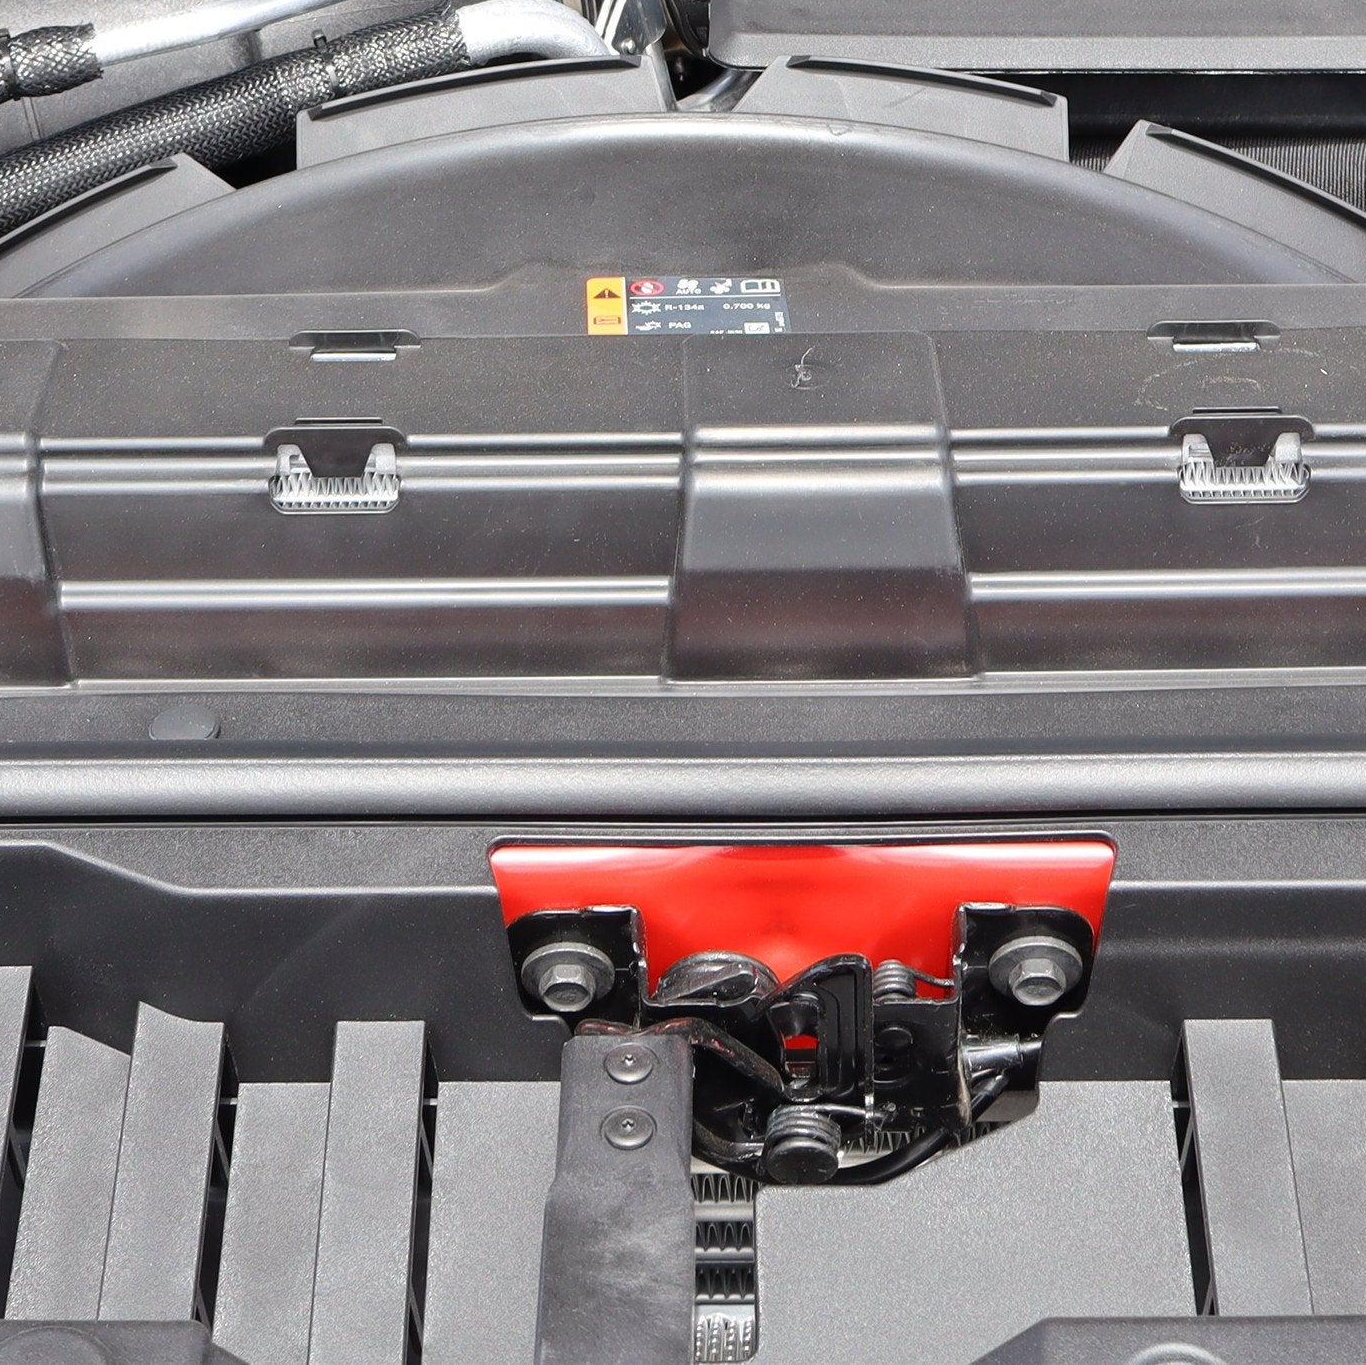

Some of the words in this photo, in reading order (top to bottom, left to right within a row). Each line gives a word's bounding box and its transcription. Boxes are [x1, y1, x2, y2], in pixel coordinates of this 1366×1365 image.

[664, 303, 705, 311] R-134a
[721, 302, 755, 310] 0.700
[668, 321, 692, 329] PAG
